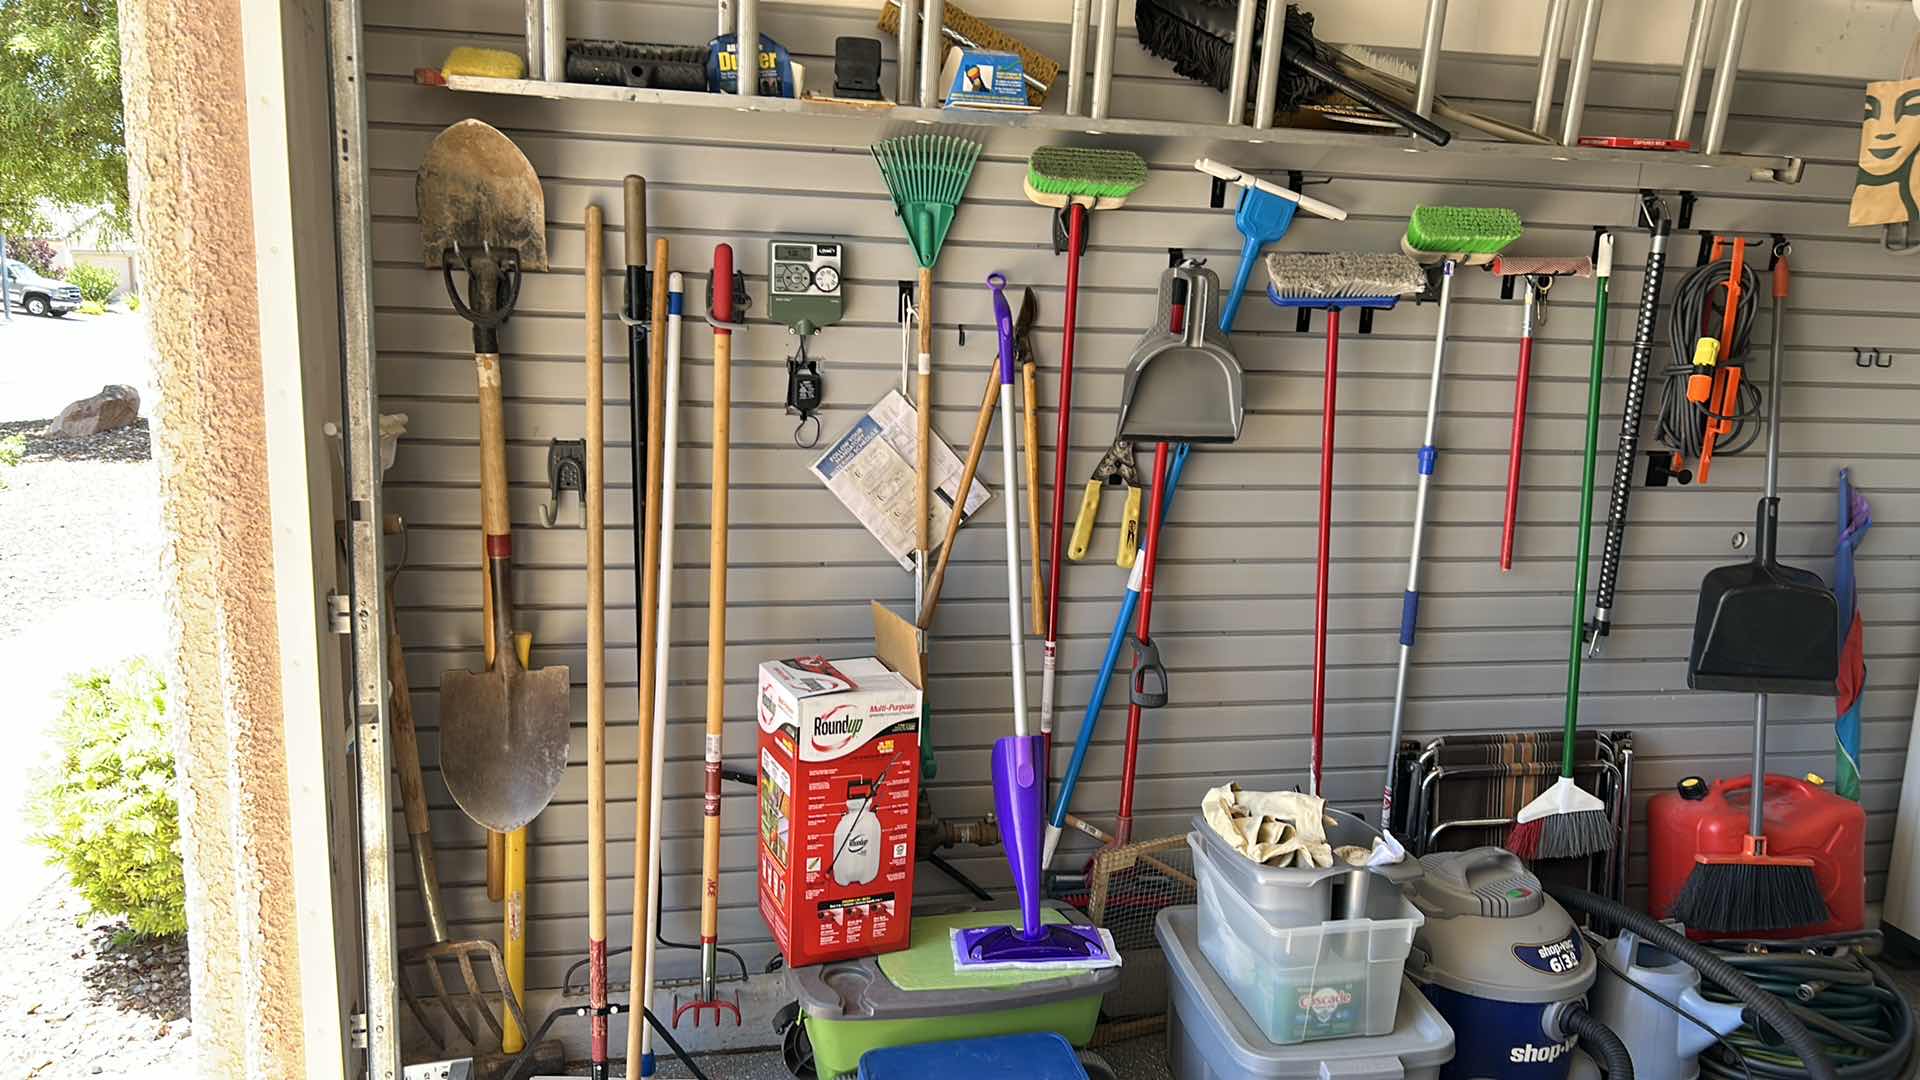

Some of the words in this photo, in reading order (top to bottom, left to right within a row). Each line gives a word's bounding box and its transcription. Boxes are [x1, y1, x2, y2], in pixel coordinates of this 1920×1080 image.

[718, 51, 776, 71] Duer
[869, 704, 915, 713] Multi-Purpose
[814, 715, 864, 738] Roundup
